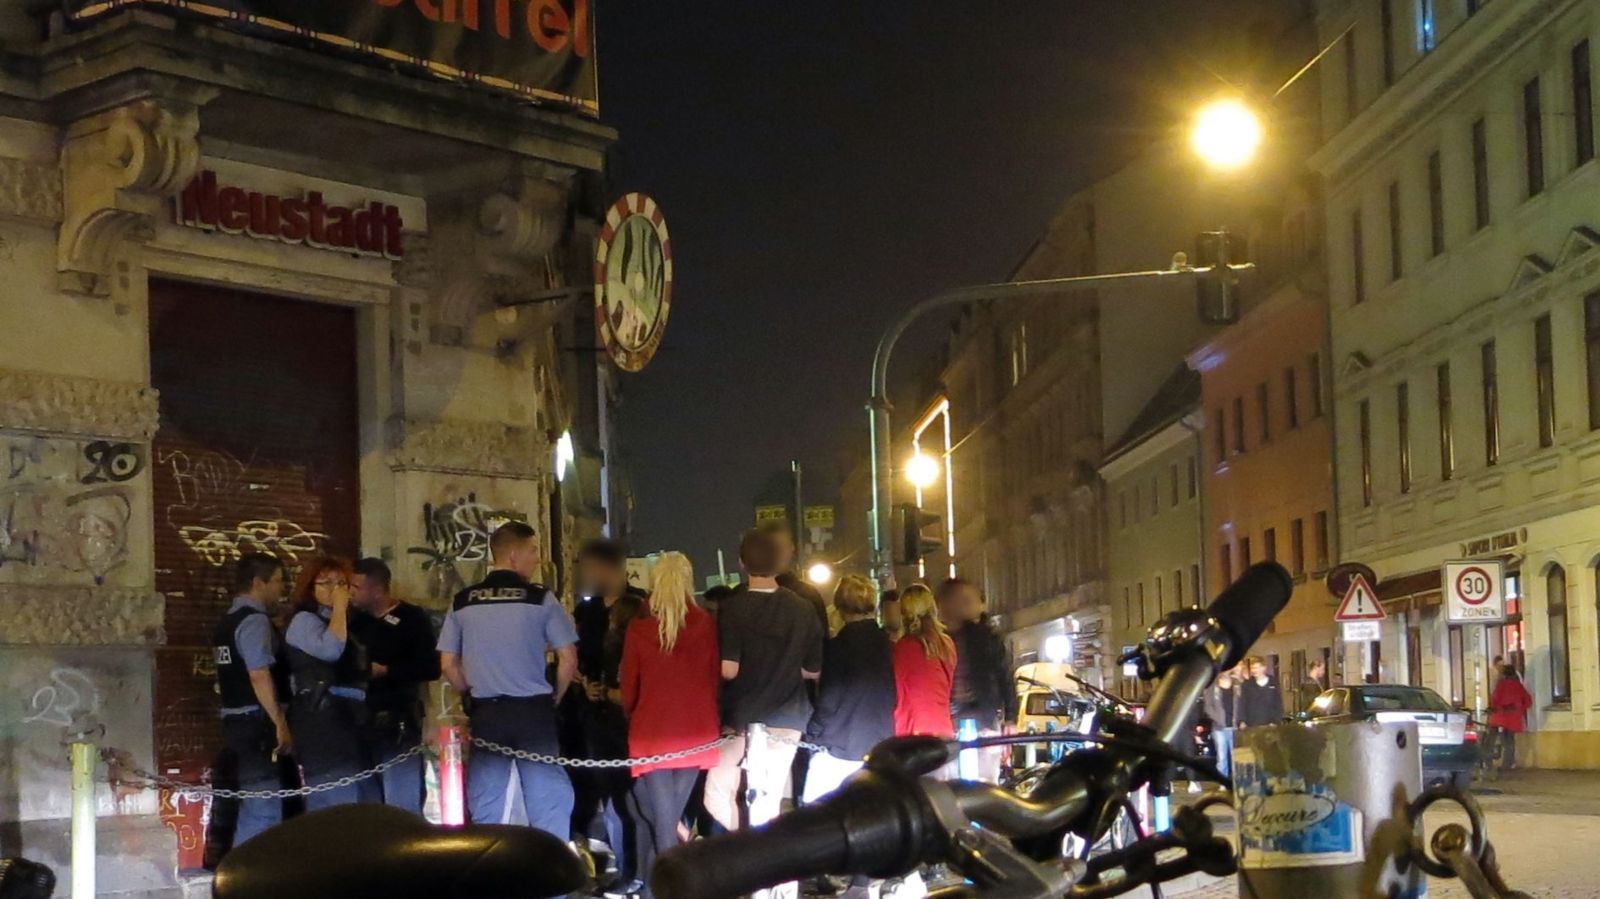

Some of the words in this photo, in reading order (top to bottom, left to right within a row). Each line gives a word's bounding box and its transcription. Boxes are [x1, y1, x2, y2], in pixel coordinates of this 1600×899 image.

[183, 169, 403, 260] Neustadt
[1463, 577, 1484, 595] 30
[1461, 606, 1489, 617] ZONE
